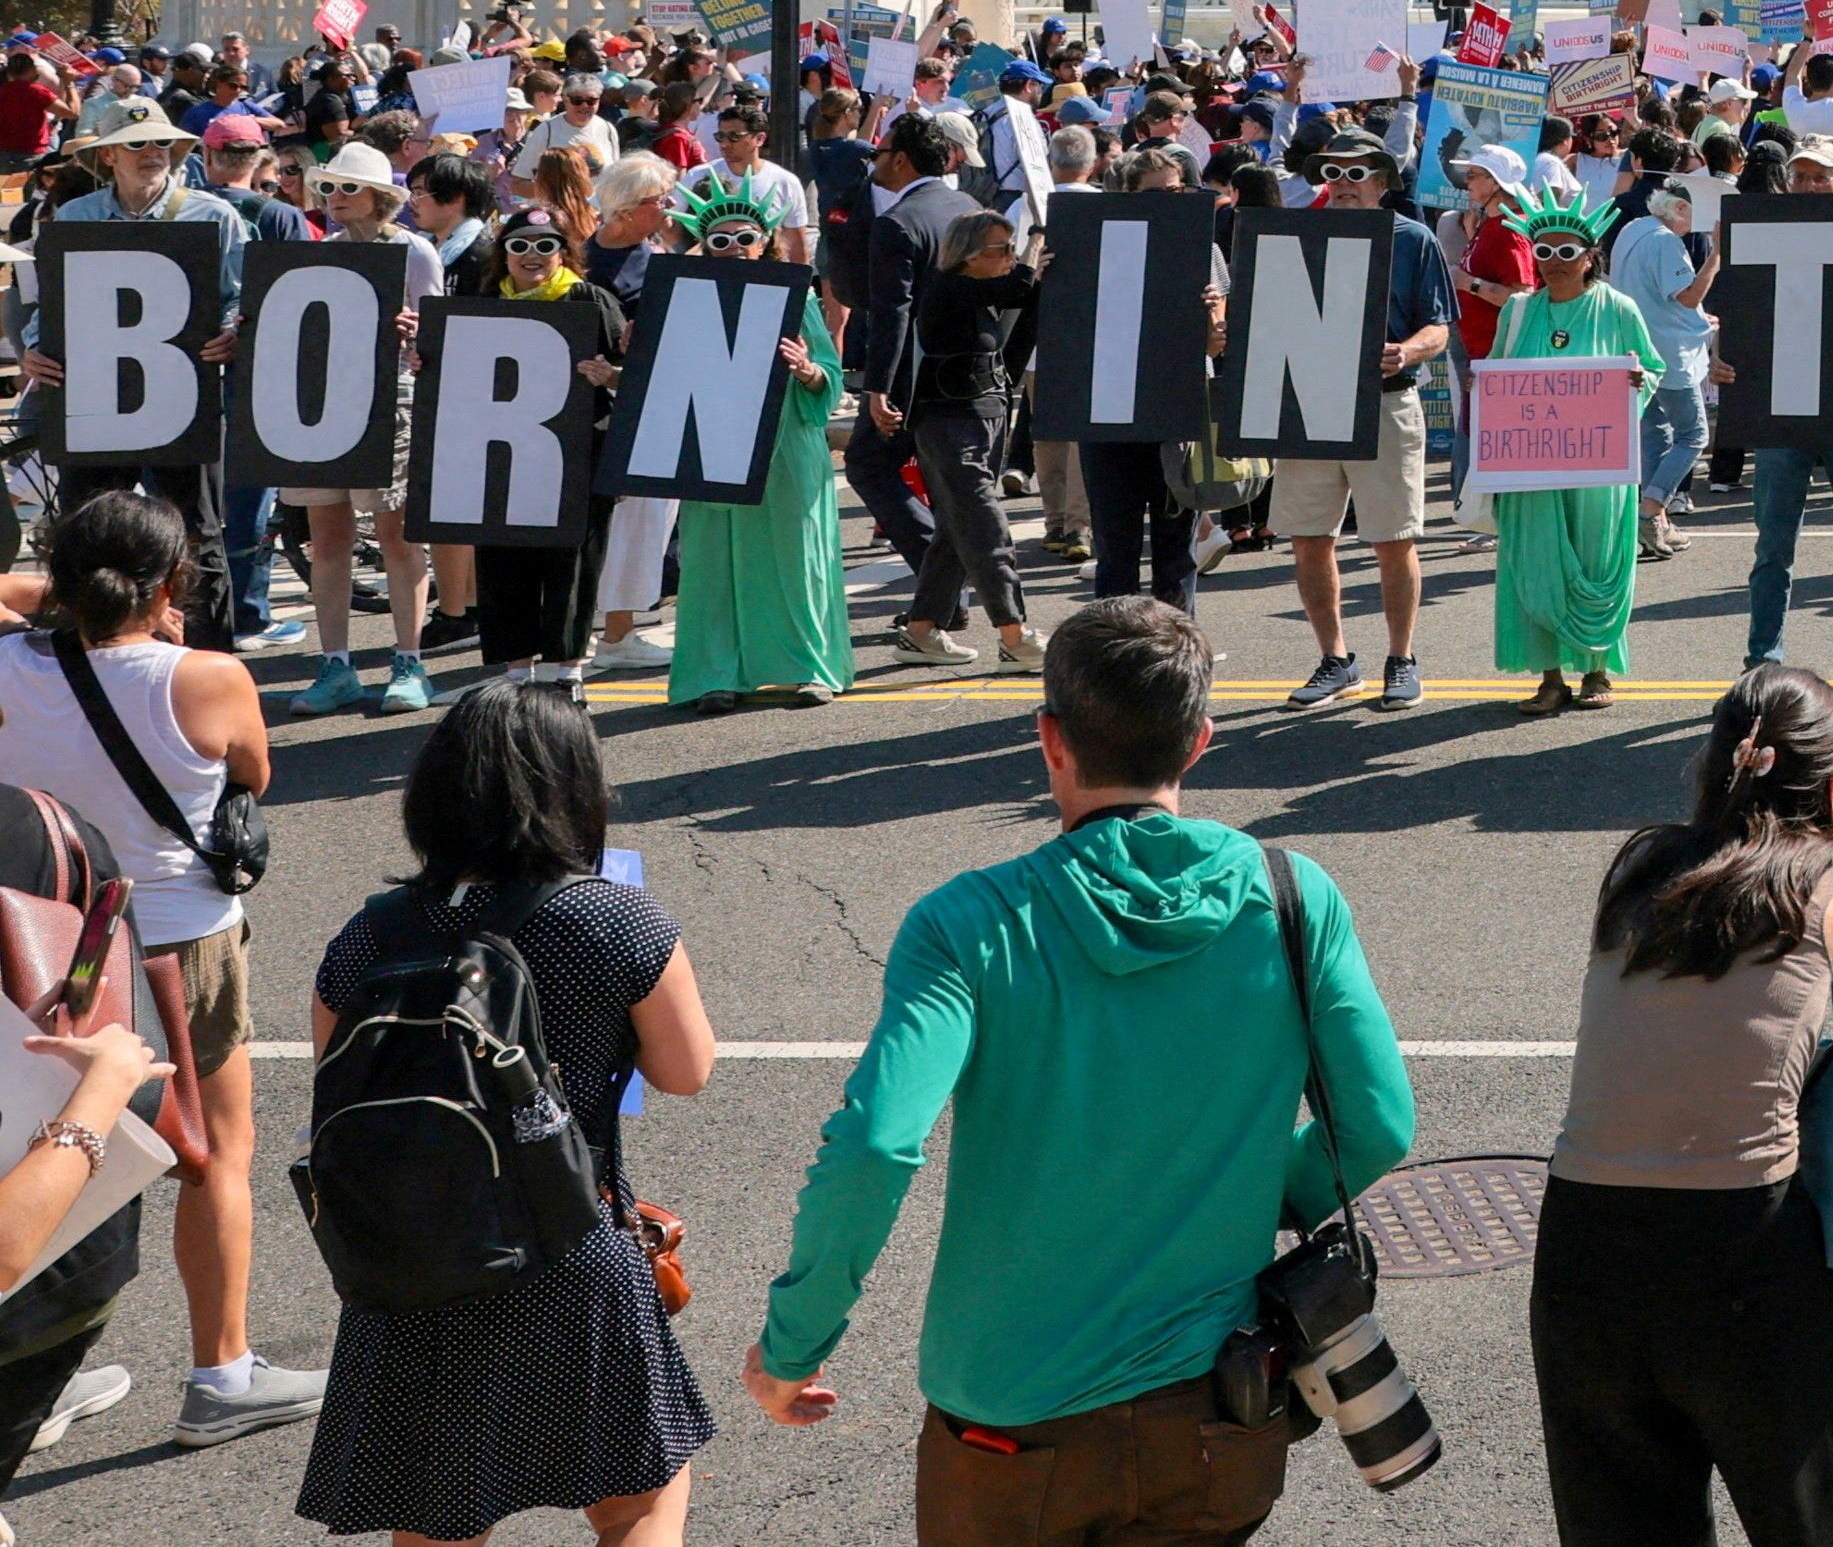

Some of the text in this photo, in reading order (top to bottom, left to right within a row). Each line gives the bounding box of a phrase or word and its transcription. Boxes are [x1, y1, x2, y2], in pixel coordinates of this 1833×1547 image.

[1817, 7, 1833, 19] CON
[1472, 20, 1493, 44] 14TH
[1437, 64, 1477, 83] MAISON
[1477, 72, 1490, 84] LA
[1500, 77, 1546, 94] RAMENER
[1560, 64, 1623, 96] CITIZENSHIP
[1565, 75, 1624, 103] BIRTHRIGHT
[1089, 220, 1148, 424] I
[1240, 234, 1372, 442] N
[65, 250, 199, 453] B
[252, 266, 377, 463] O
[627, 277, 790, 485] N
[430, 315, 571, 527] R
[1520, 403, 1559, 421] IS A
[1479, 425, 1613, 461] BIRTHRIGHT
